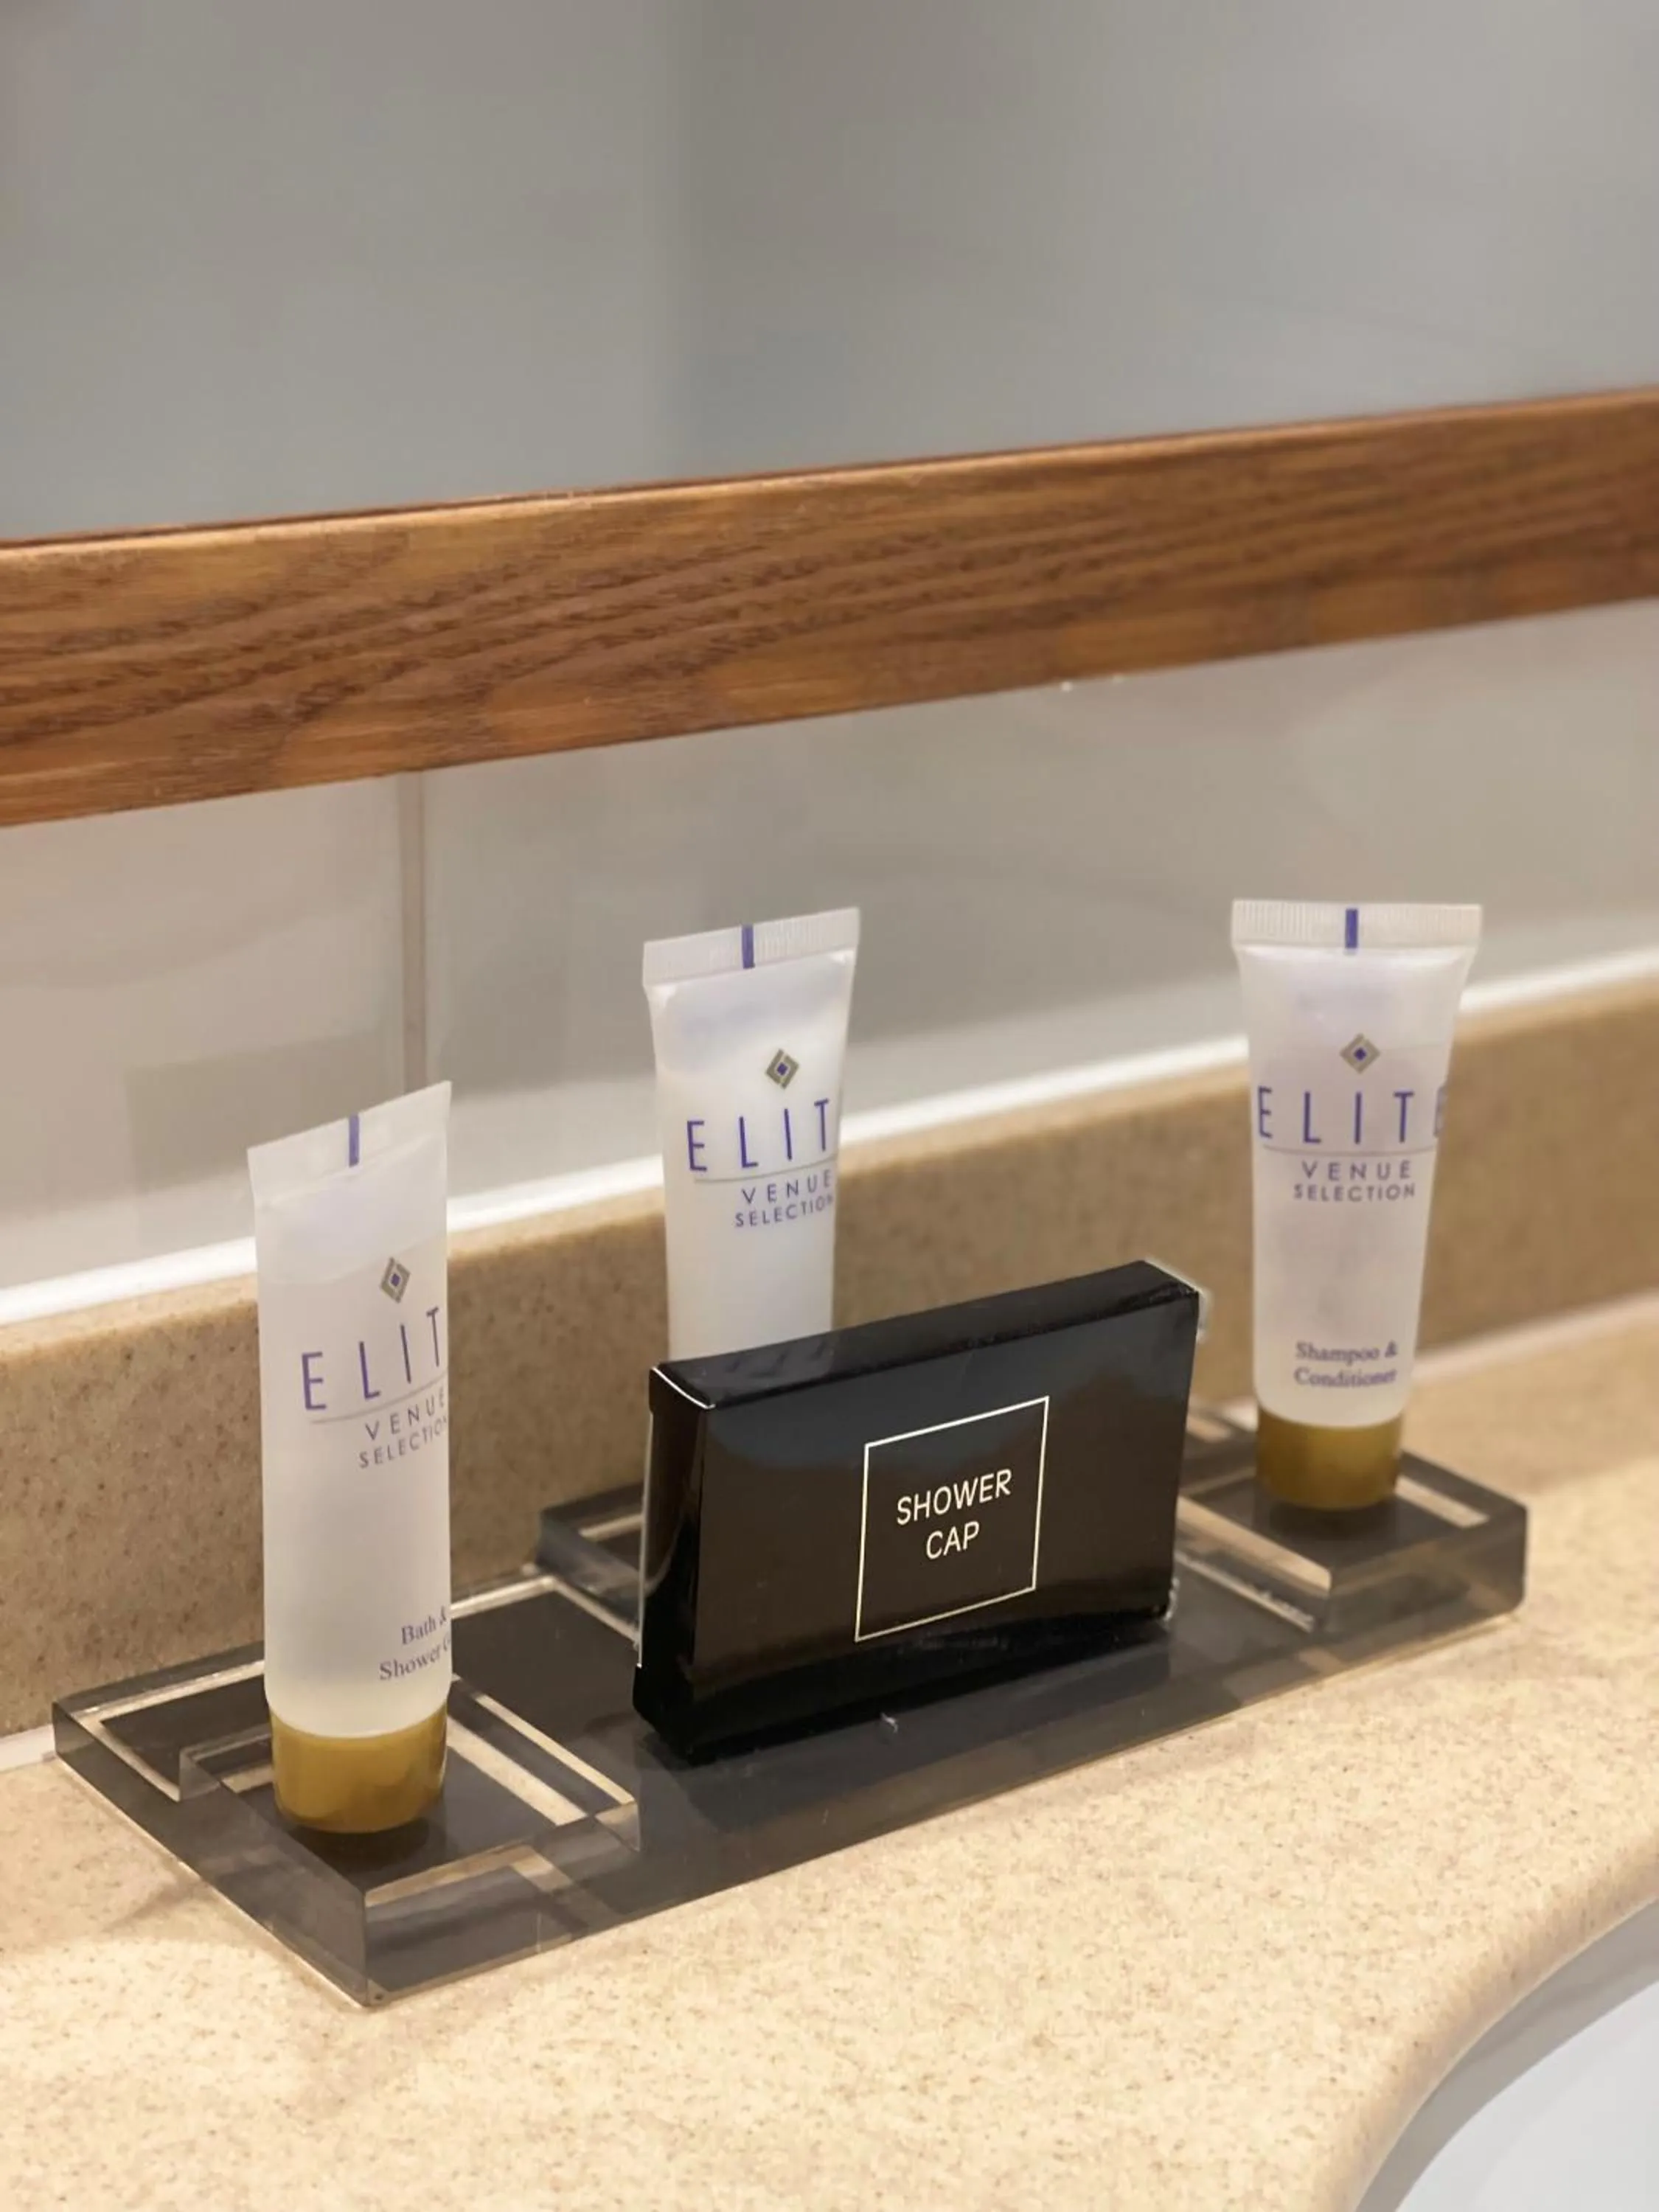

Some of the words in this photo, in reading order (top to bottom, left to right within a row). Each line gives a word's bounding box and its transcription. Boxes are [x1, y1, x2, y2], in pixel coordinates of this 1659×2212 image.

[686, 1097, 830, 1172] ELIT
[742, 1169, 831, 1204] VENUE
[1301, 1160, 1411, 1181] VENUE
[1293, 1183, 1415, 1203] SELECTION
[301, 1307, 439, 1410] ELIT
[1295, 1340, 1380, 1366] Shampoo
[1384, 1339, 1397, 1358] &
[1293, 1366, 1397, 1388] Conditioner
[896, 1468, 1012, 1526] SHOWER
[925, 1520, 980, 1560] CAP
[400, 1614, 437, 1645] Bath
[378, 1644, 441, 1680] Shower
